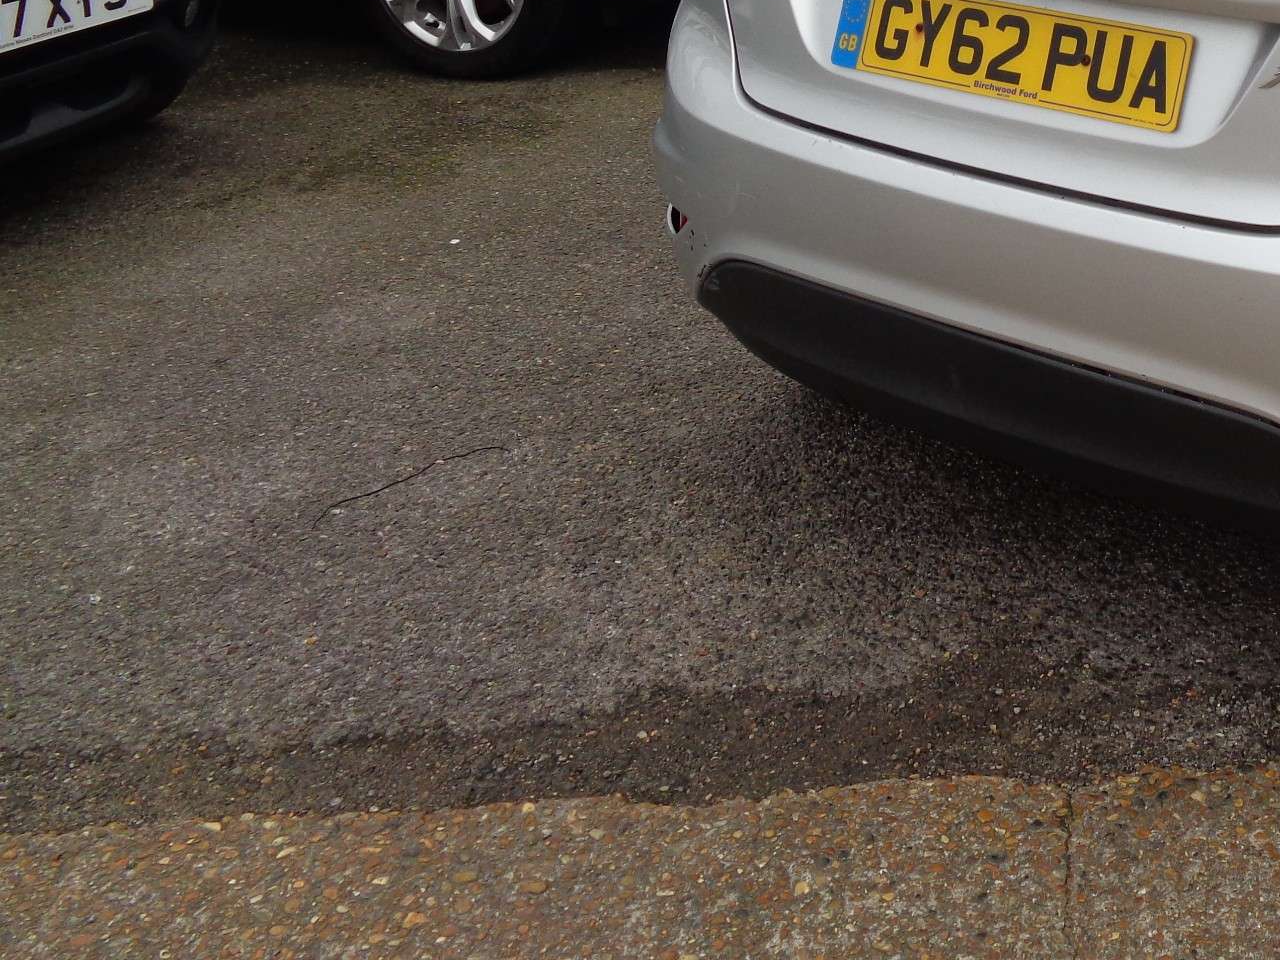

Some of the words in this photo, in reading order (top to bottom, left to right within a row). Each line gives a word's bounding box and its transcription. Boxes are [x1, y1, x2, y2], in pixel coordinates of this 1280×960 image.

[838, 31, 857, 52] GB
[1041, 22, 1168, 114] PUA
[973, 79, 1017, 96] Birchwood
[1018, 87, 1038, 100] Ford
